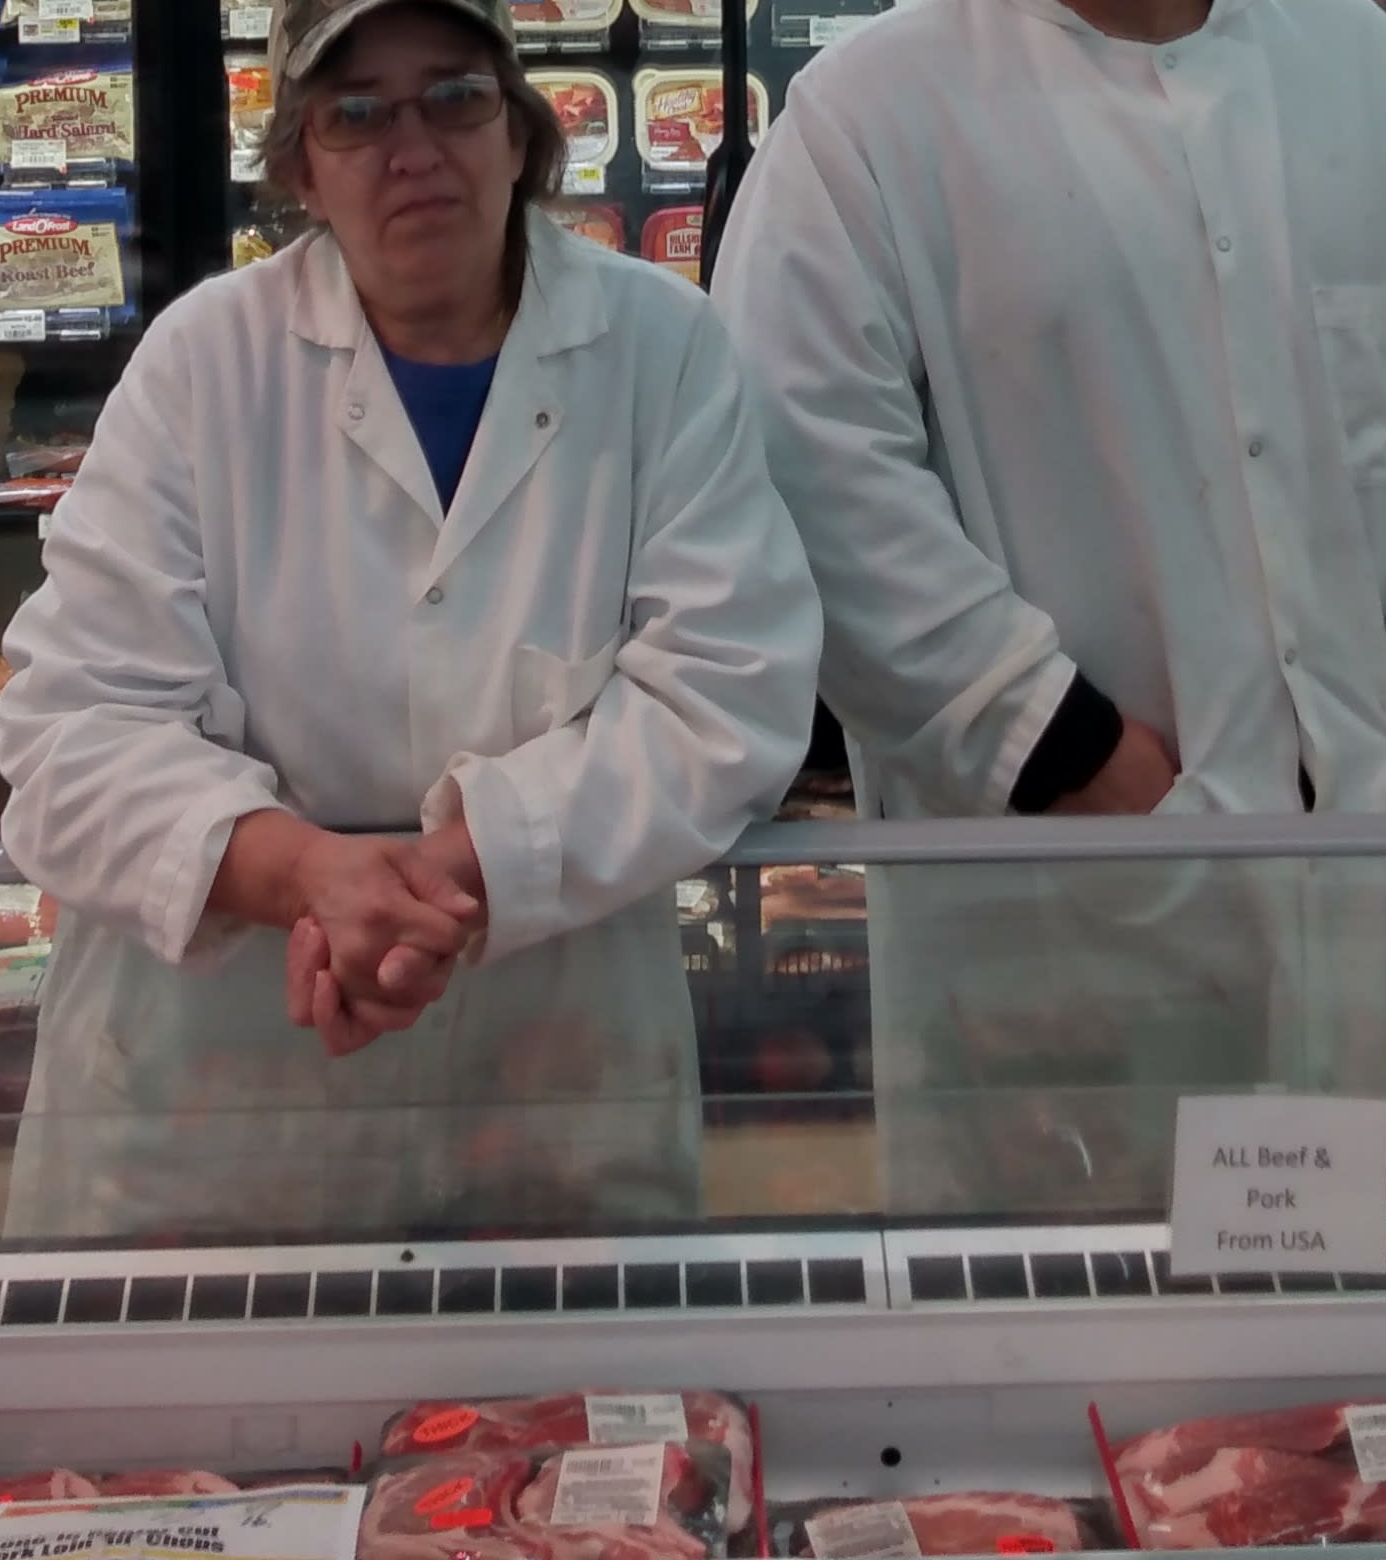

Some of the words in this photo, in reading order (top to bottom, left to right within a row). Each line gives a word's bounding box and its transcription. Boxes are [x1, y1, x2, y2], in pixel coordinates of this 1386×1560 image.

[15, 86, 109, 114] PREMIUM
[1212, 1146, 1250, 1168] ALL
[1258, 1146, 1307, 1168] Beef
[1314, 1146, 1332, 1169] &
[1247, 1188, 1297, 1209] Pork
[1218, 1230, 1273, 1251] From
[1281, 1230, 1326, 1252] USA
